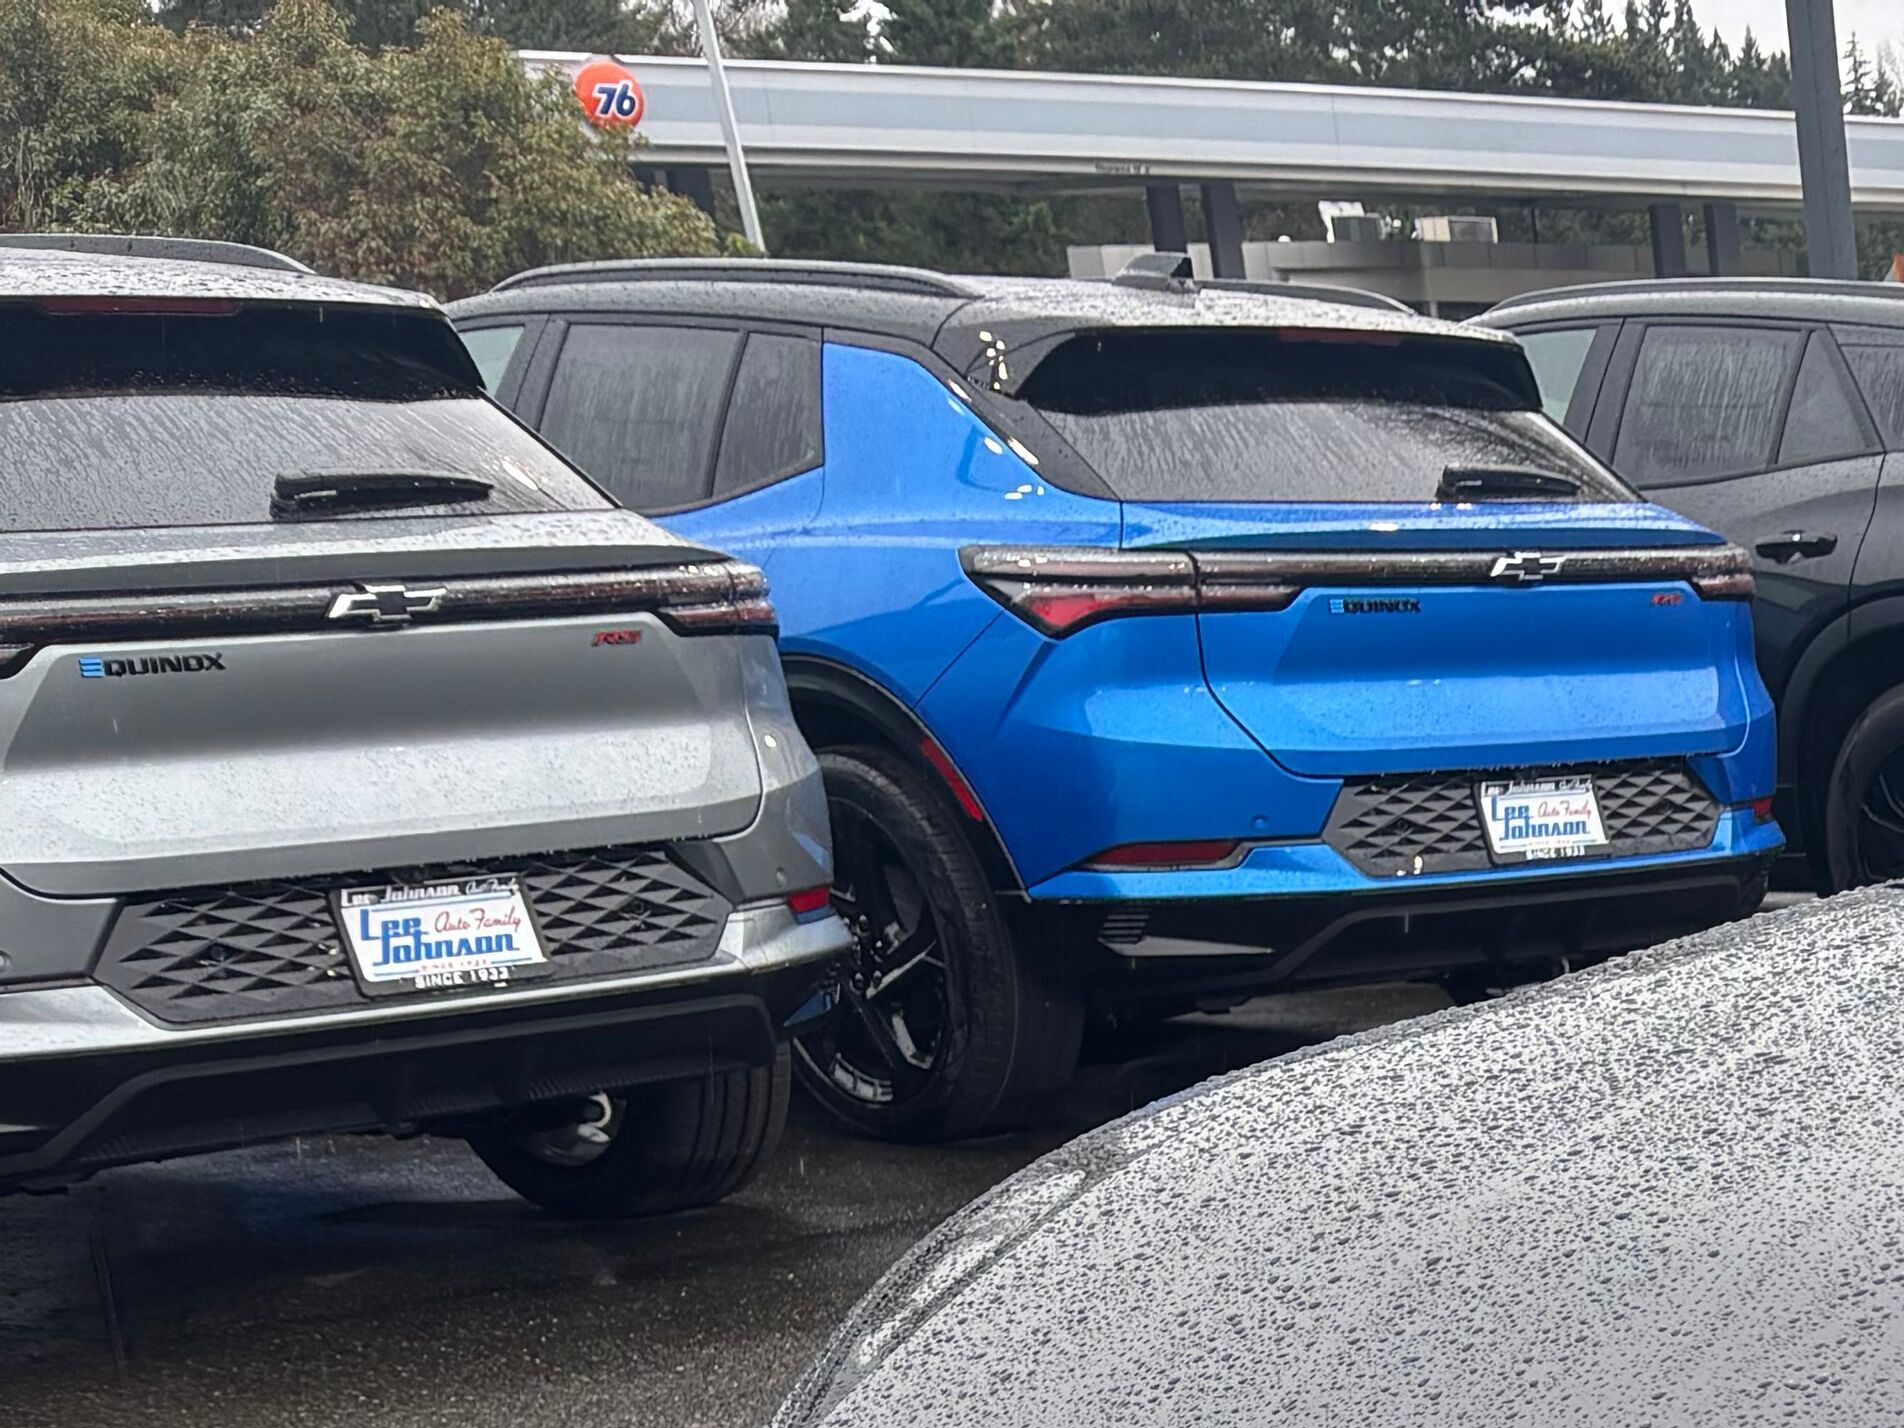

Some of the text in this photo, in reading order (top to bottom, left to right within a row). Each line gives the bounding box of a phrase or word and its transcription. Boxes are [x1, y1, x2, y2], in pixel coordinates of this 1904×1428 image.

[592, 81, 637, 118] 76
[79, 652, 226, 678] EQUINOX
[1491, 797, 1534, 821] Lee
[1560, 800, 1592, 819] Family
[1499, 814, 1591, 841] Johnson
[380, 884, 461, 903] Johnson
[360, 905, 522, 941] Lee Auto Family
[372, 930, 520, 967] Johnson
[414, 966, 509, 989] SINCE 1933
